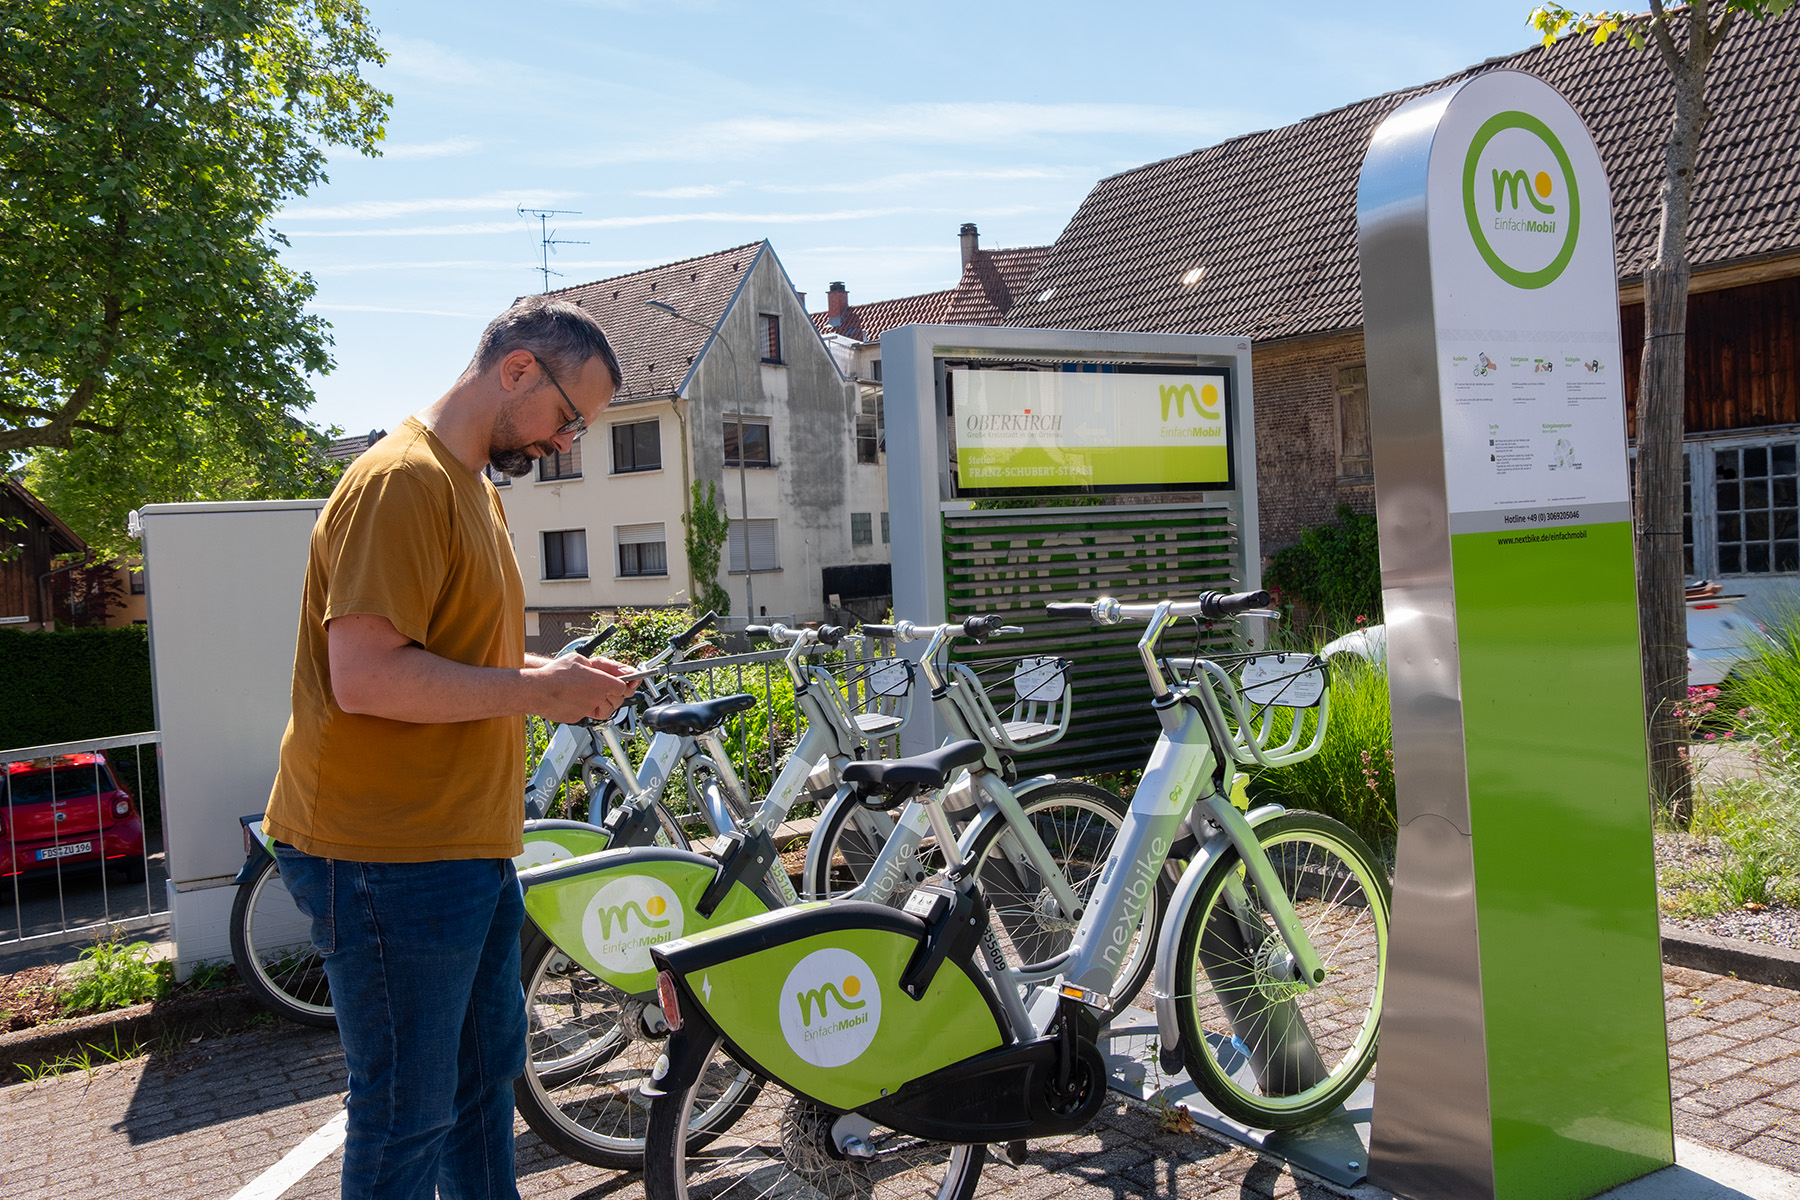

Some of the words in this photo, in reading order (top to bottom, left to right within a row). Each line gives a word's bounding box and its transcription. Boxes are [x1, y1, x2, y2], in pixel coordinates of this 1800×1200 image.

[1494, 217, 1556, 233] EinfachMobil
[966, 411, 1064, 431] OBERKIRCH
[967, 431, 984, 439] Große
[987, 431, 1019, 439] Kreisstadt
[1160, 427, 1222, 438] EinfachMobil
[968, 455, 996, 464] Station
[1504, 514, 1526, 524] Hotline
[1527, 513, 1537, 522] +49
[1538, 512, 1546, 522] (0)
[1546, 510, 1580, 521] 3069205046
[1497, 530, 1587, 545] www.nextbike.de/einfachmobil
[42, 848, 58, 859] FDS
[64, 846, 75, 855] ZU
[76, 843, 91, 853] 196
[771, 862, 796, 901] 355145
[1102, 836, 1167, 966] nextbike
[603, 931, 672, 954] EinfachMobil
[804, 1012, 868, 1042] EinfachMobil
